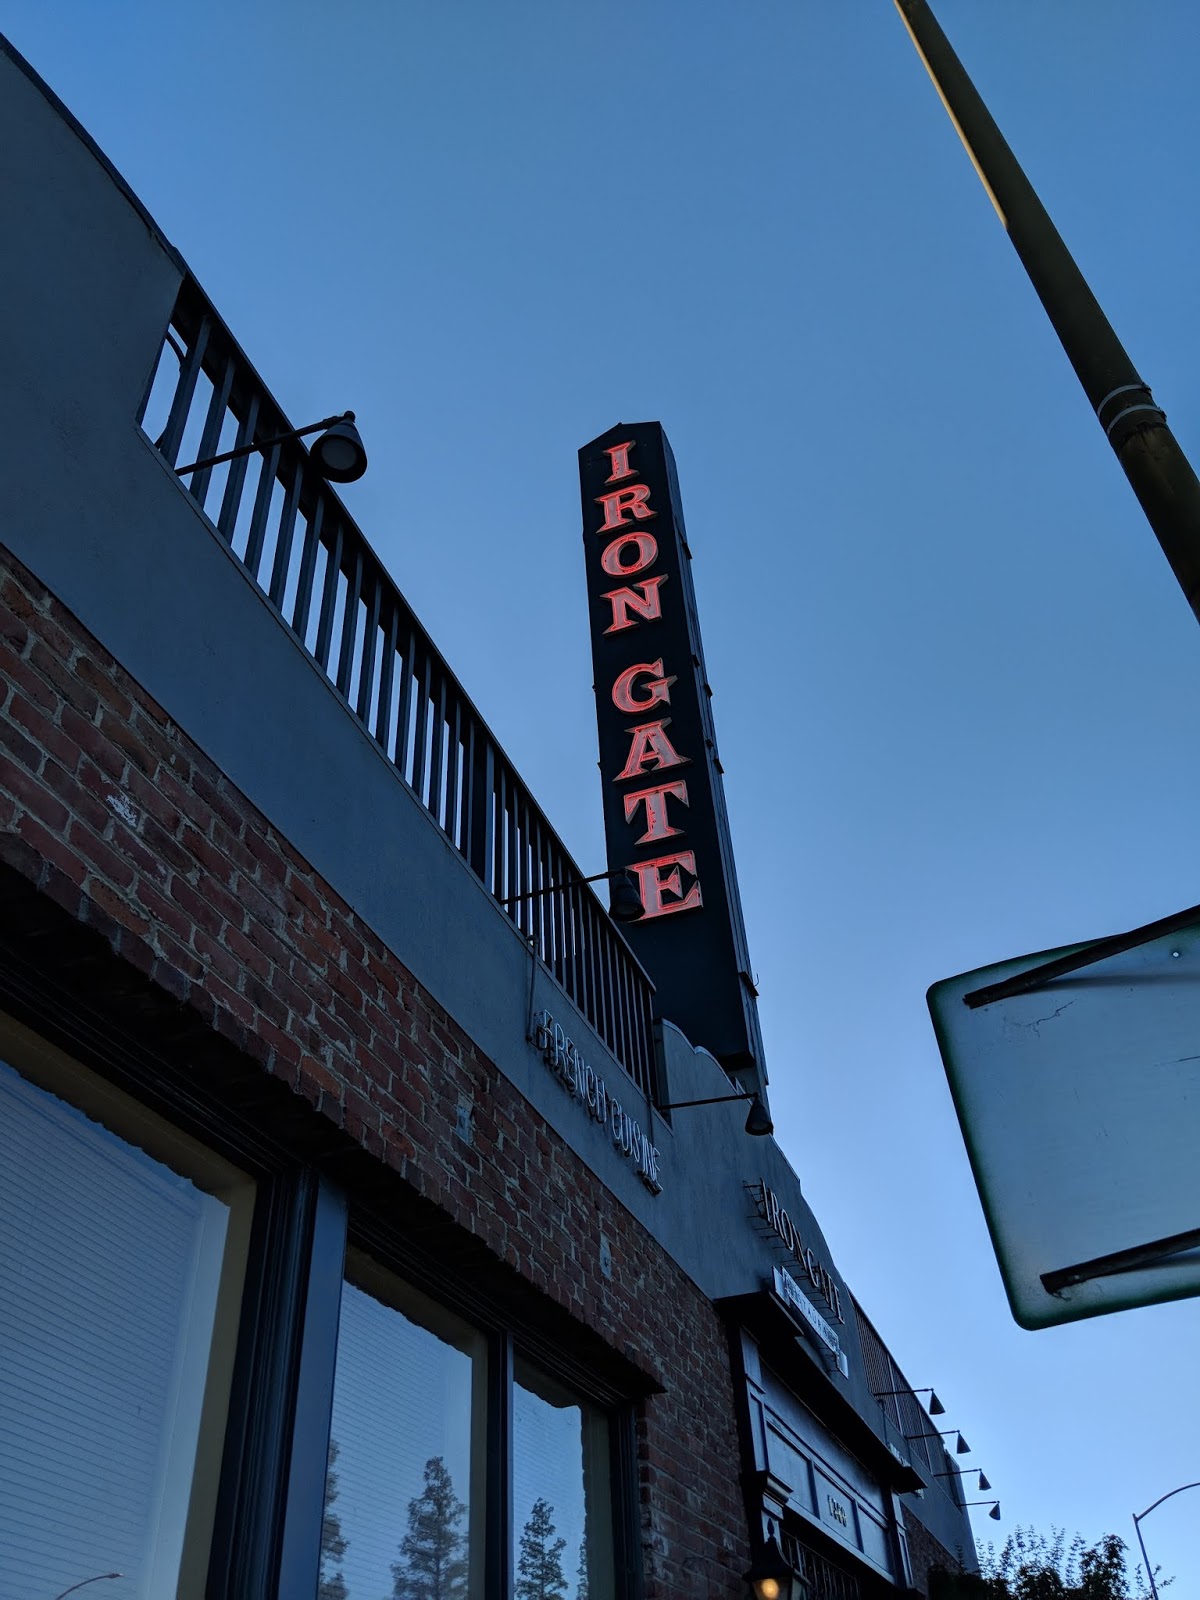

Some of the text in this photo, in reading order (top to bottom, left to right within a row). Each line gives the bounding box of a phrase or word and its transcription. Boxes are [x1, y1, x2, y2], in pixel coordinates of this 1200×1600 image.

[593, 440, 703, 924] IRON GATE
[536, 1009, 663, 1194] FRENCH CUISINE
[760, 1177, 808, 1271] IRON
